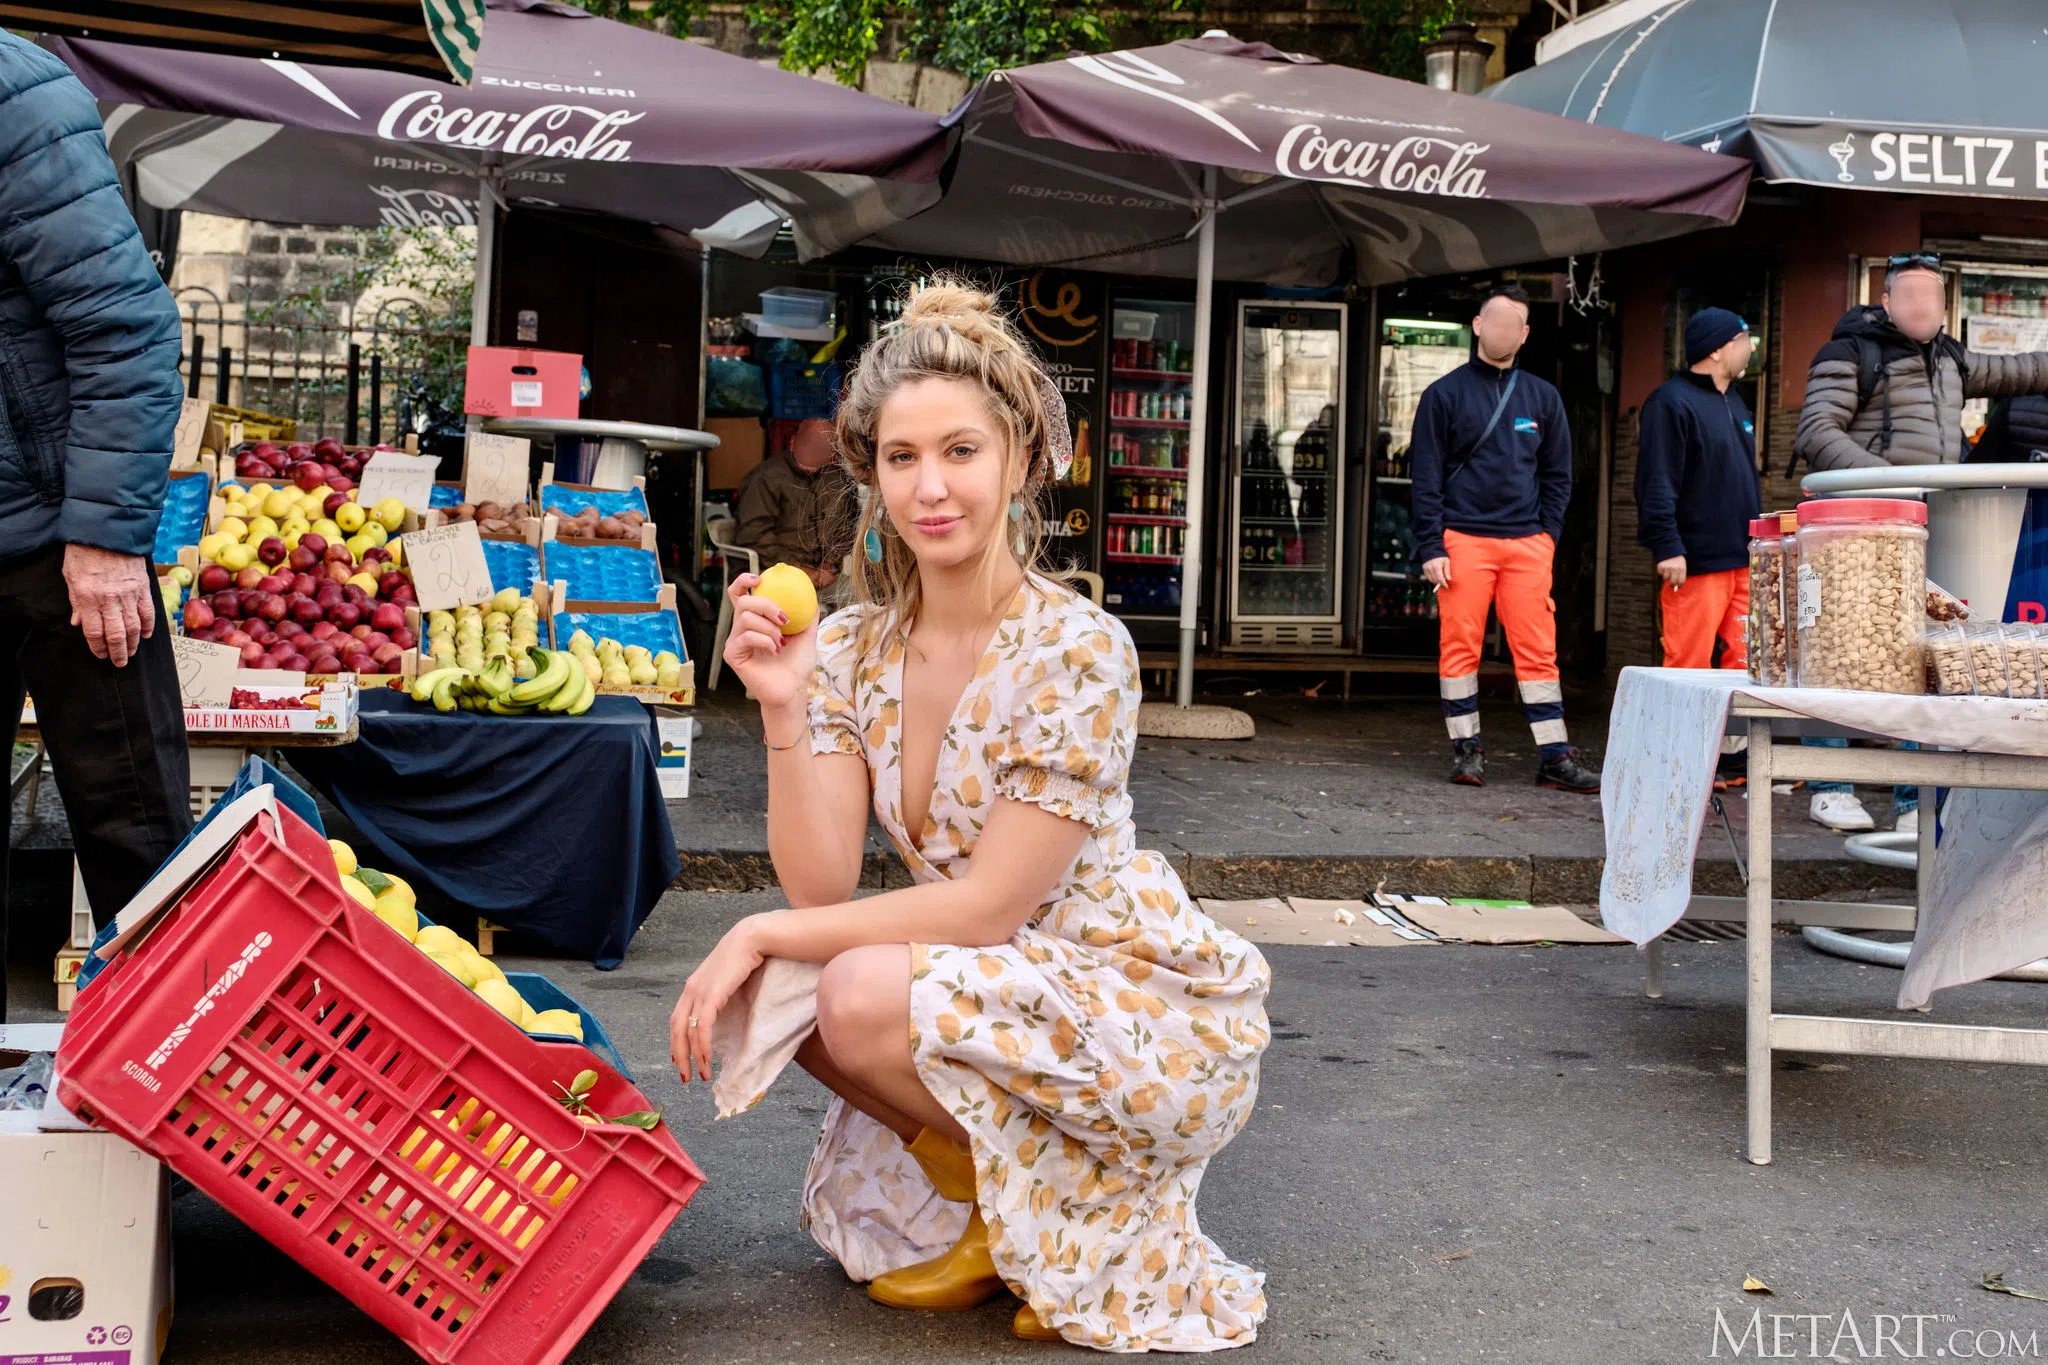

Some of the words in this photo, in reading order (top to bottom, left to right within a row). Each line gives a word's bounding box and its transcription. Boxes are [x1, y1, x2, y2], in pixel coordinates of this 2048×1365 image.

[481, 76, 636, 98] ZUCCHERI
[377, 90, 647, 162] Coca-Cola
[1276, 124, 1491, 199] Coca-Cola
[1870, 132, 2016, 188] SELTZ
[214, 713, 228, 728] DI
[232, 714, 291, 729] MARSALA
[120, 1059, 163, 1094] SCORDIA
